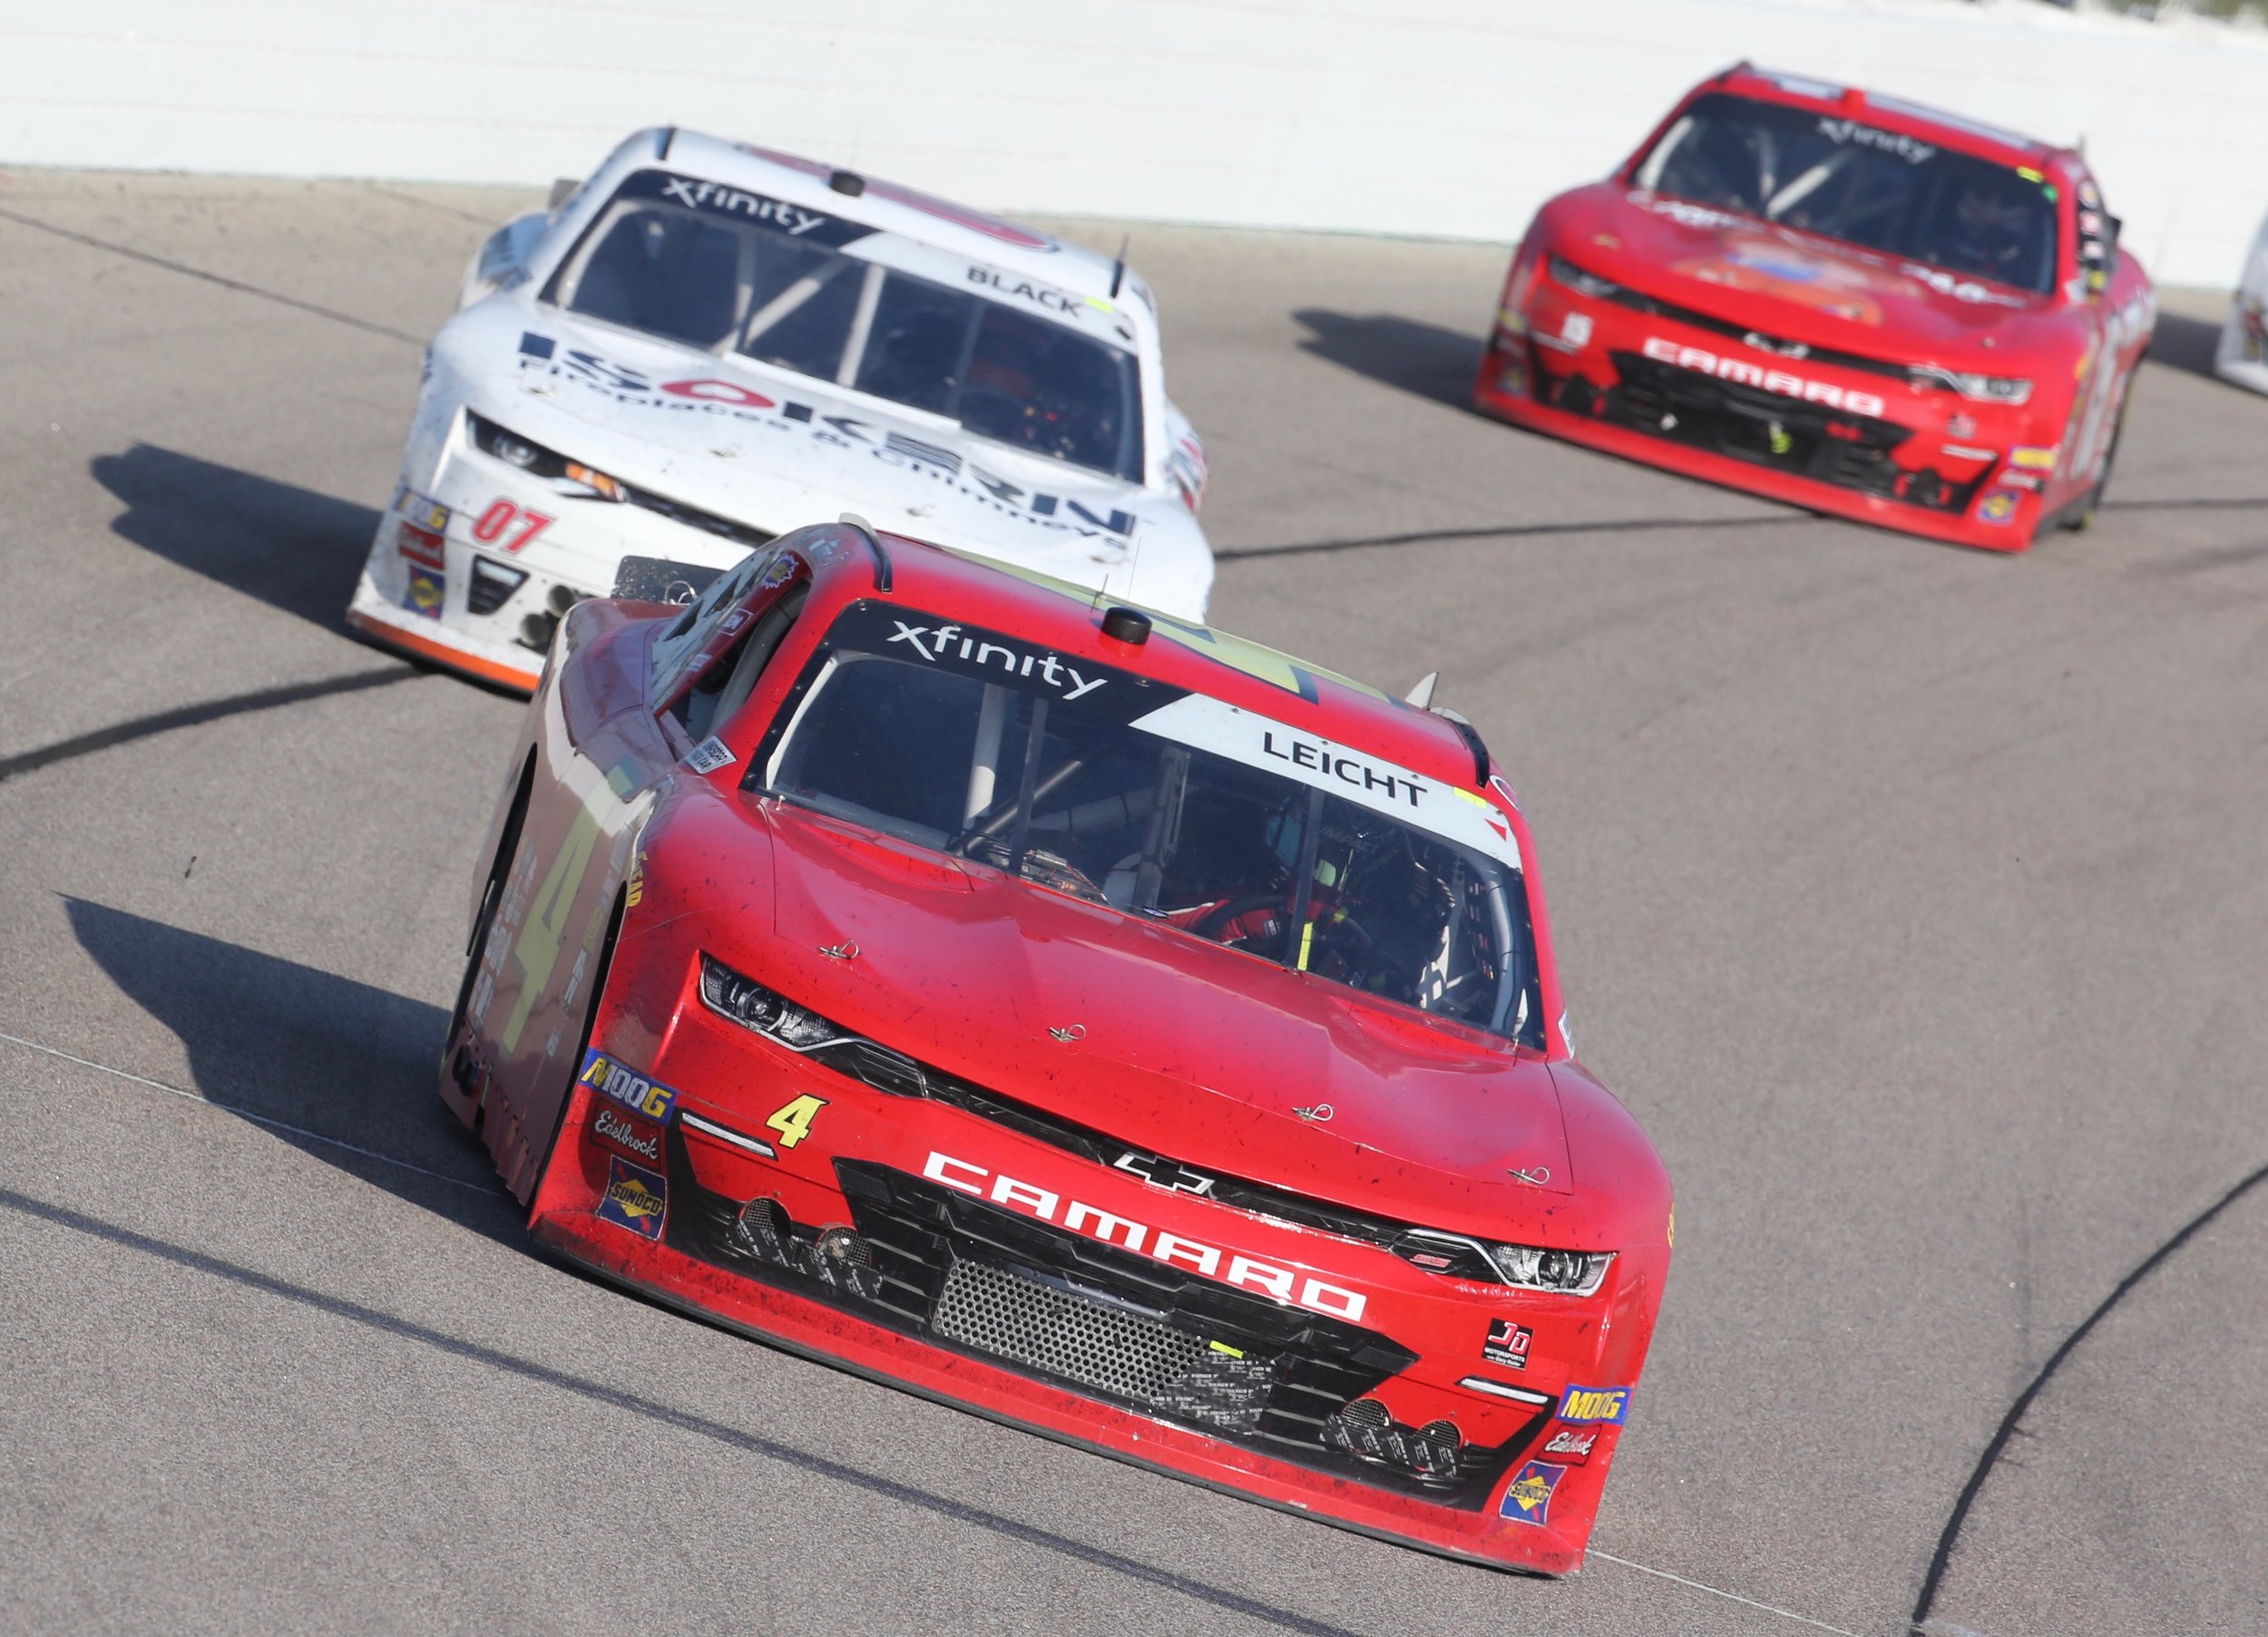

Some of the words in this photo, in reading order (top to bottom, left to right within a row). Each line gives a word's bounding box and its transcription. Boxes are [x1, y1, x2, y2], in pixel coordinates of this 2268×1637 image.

[661, 177, 826, 236] xfinity
[966, 266, 1084, 319] BLACK
[1642, 336, 1884, 418] CAMARO
[471, 494, 556, 556] 07
[886, 620, 1109, 700] xfinity
[1263, 731, 1429, 808] LEICHT
[581, 1057, 673, 1120] MOOG
[594, 1109, 659, 1161] Edelbrock
[765, 1093, 831, 1150] 4
[610, 1184, 661, 1215] SUNOCO
[923, 1151, 1367, 1323] CAMARO
[1560, 1390, 1626, 1419] MOOG
